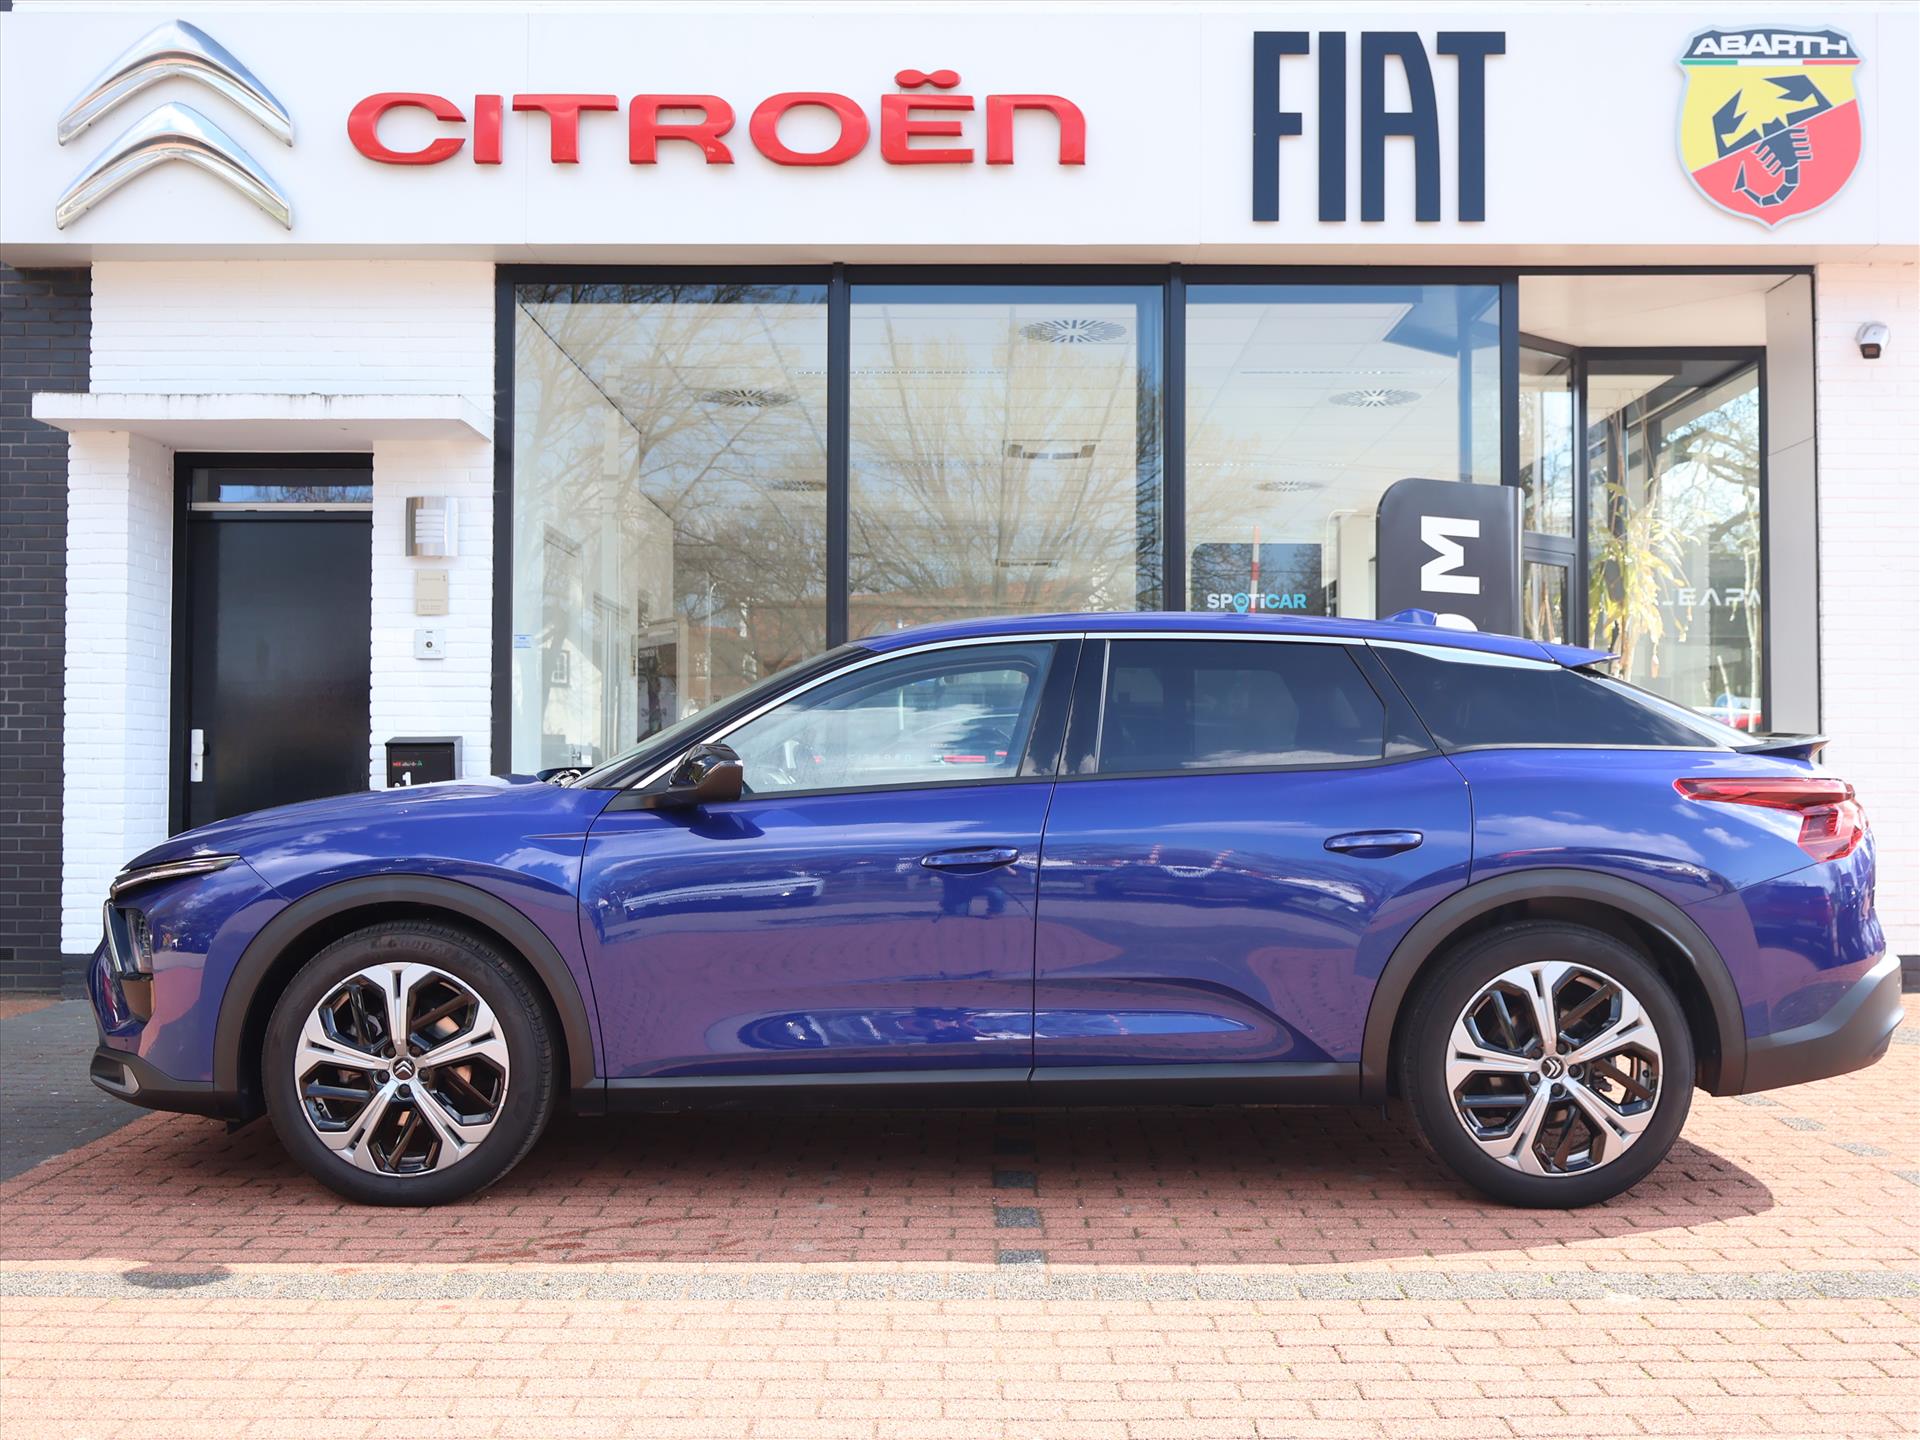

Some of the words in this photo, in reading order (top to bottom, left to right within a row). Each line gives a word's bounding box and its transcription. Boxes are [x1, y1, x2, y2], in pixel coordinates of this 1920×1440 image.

[1692, 34, 1848, 56] ABARTH
[347, 69, 1087, 167] CITROËN
[1252, 32, 1506, 222] FIAT
